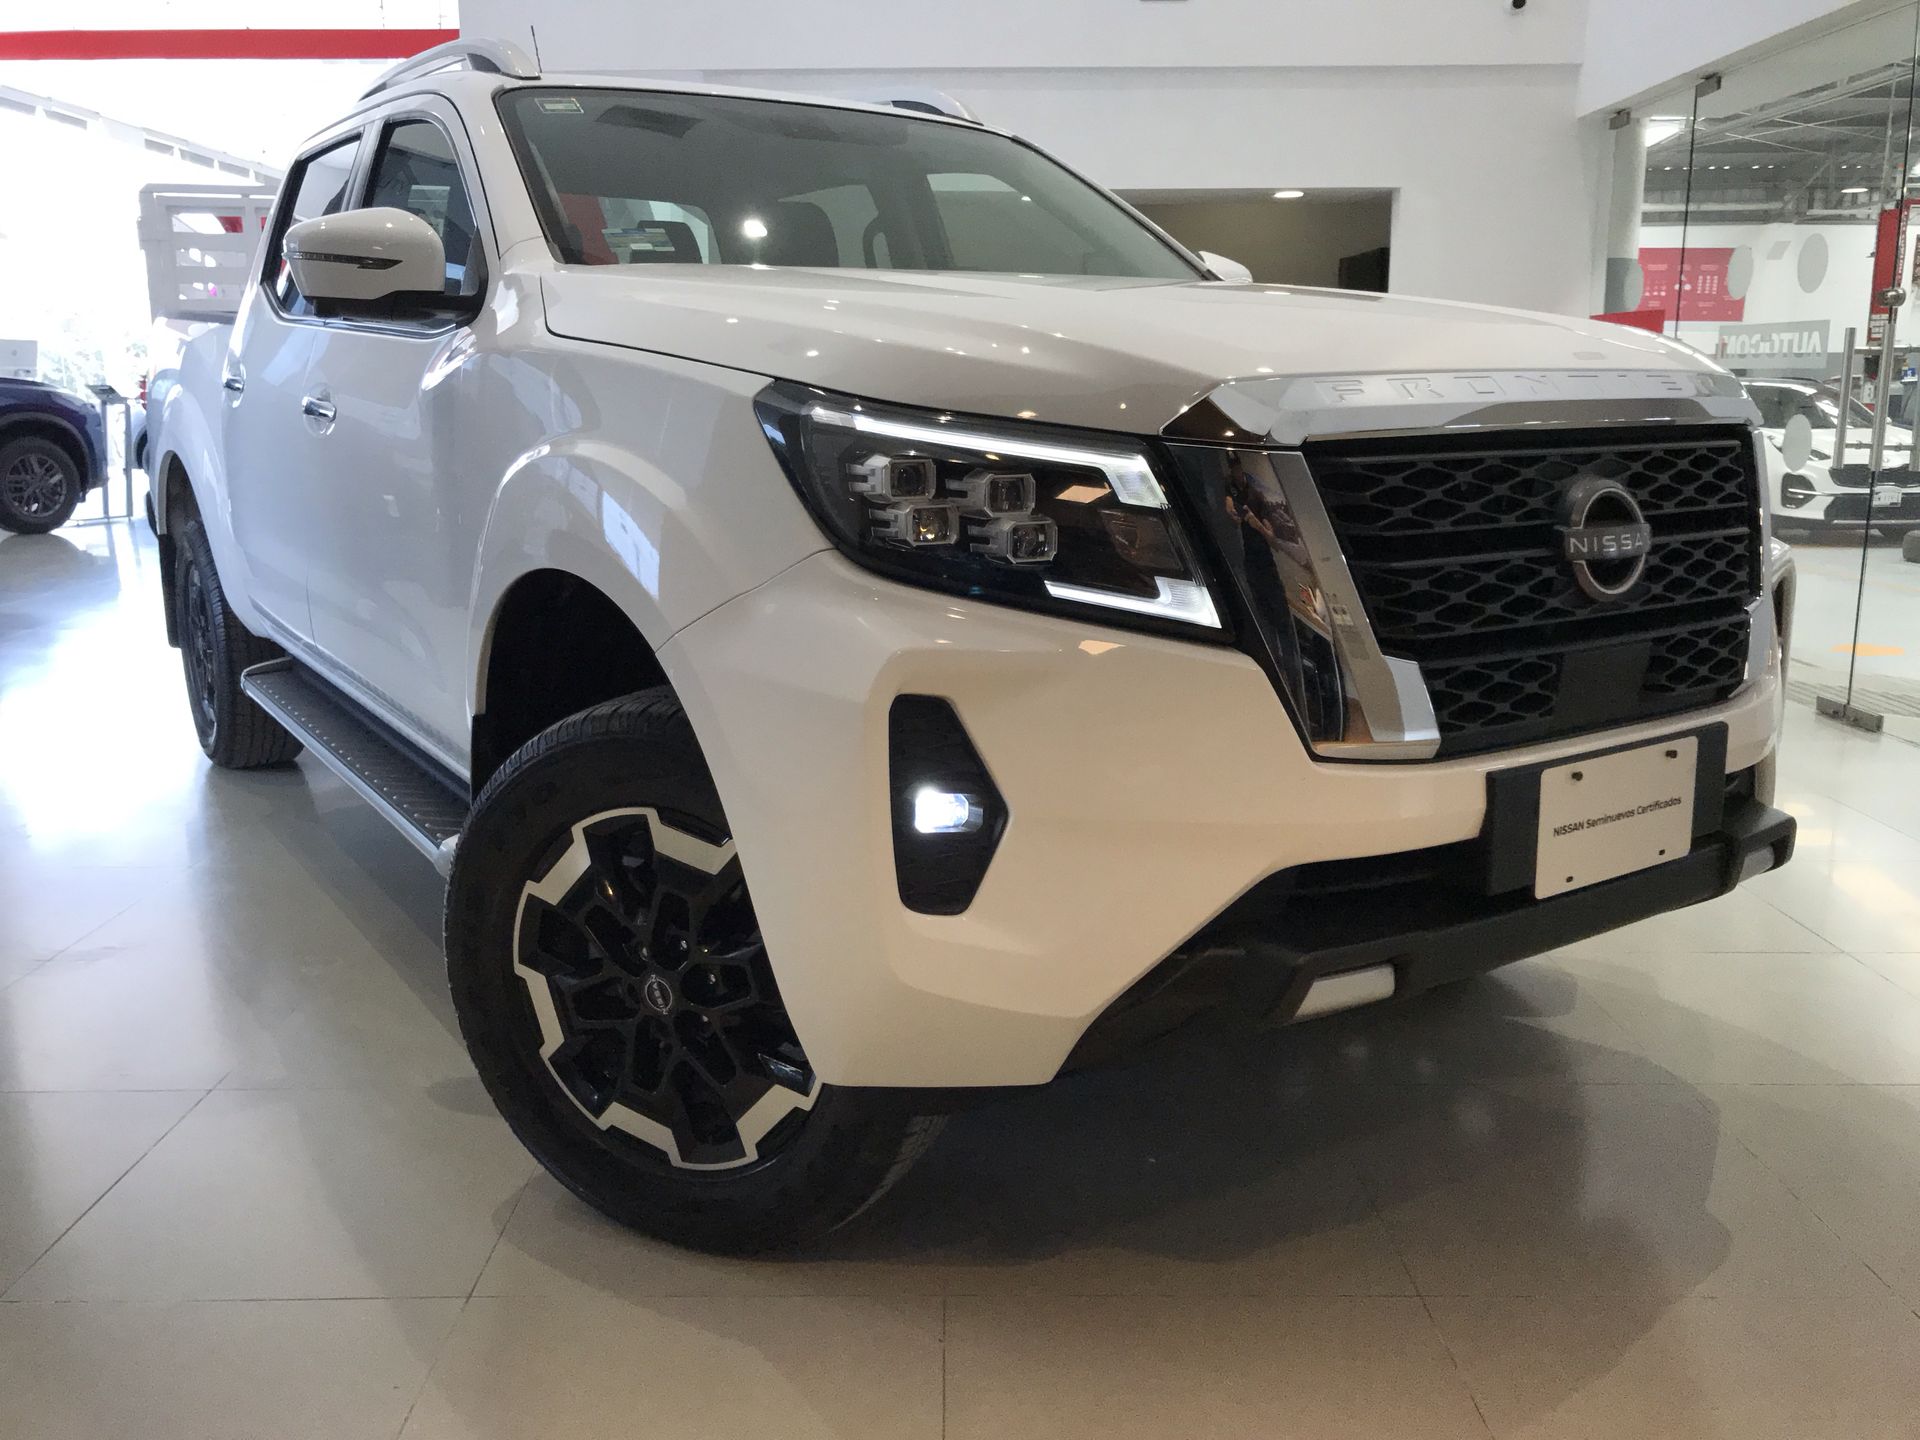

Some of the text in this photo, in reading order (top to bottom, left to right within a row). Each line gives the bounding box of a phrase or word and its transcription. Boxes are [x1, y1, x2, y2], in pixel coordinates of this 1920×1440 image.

[1553, 796, 1682, 837] NISSAN Seminuevos Certificados
